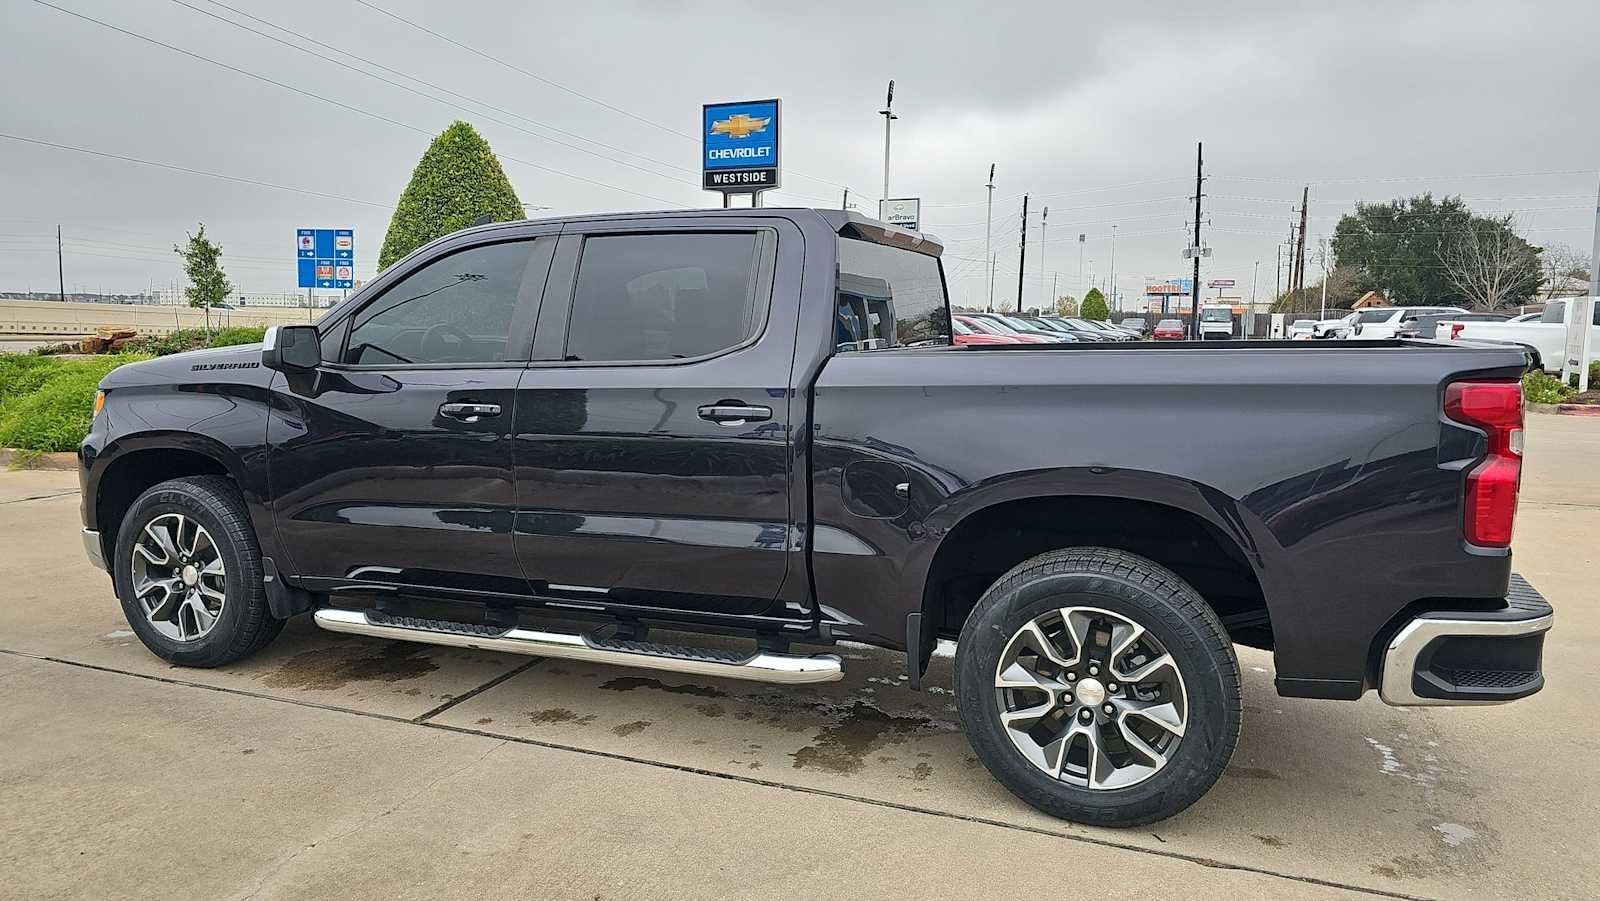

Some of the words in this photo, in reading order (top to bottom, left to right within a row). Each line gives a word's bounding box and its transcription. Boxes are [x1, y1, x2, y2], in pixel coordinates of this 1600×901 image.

[709, 146, 771, 159] CHEVROLET
[713, 172, 767, 183] WESTSIDE
[191, 362, 260, 371] SILVERADO
